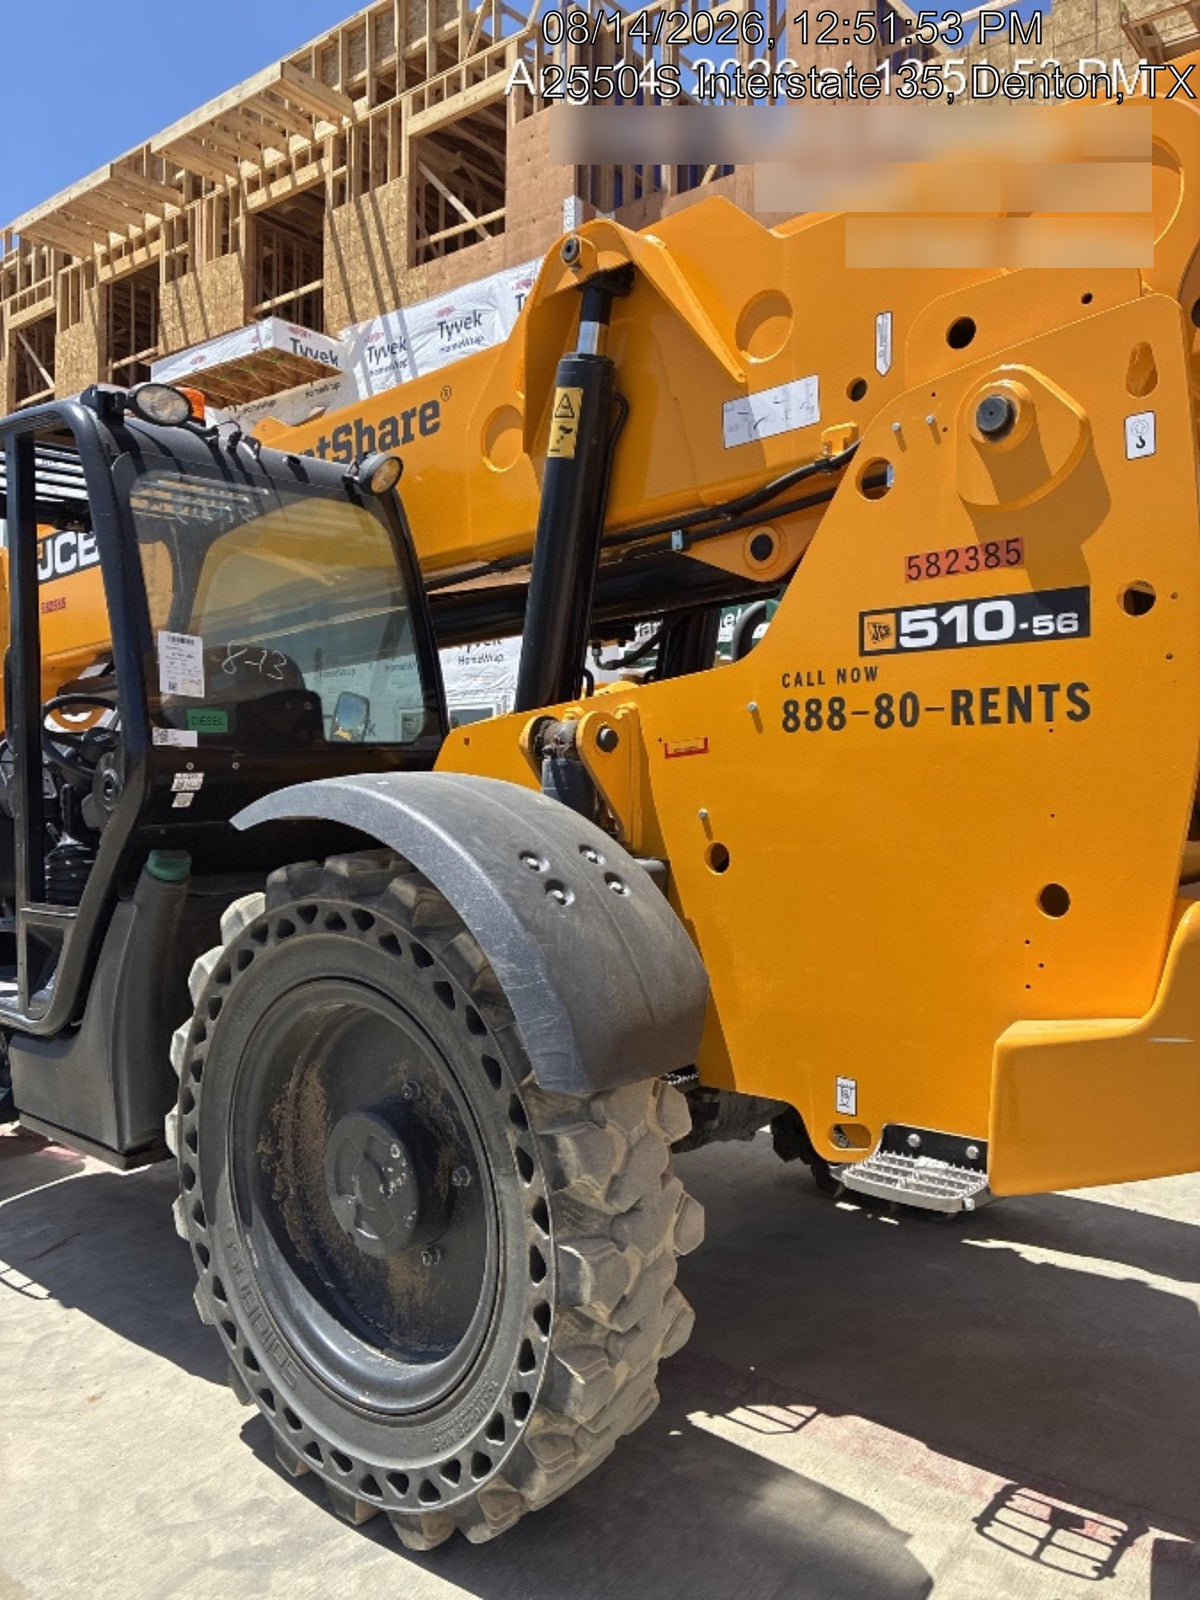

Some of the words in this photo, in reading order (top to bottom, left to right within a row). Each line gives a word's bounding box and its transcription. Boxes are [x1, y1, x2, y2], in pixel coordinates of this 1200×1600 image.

[438, 309, 483, 342] Tyvek
[367, 336, 407, 365] Tyvek
[906, 537, 1022, 581] 582385
[899, 600, 1079, 648] 510-56
[781, 670, 826, 688] CALL
[836, 666, 879, 684] NOW
[191, 715, 224, 727] DIESEL
[781, 682, 1092, 733] 888-80-RENTS
